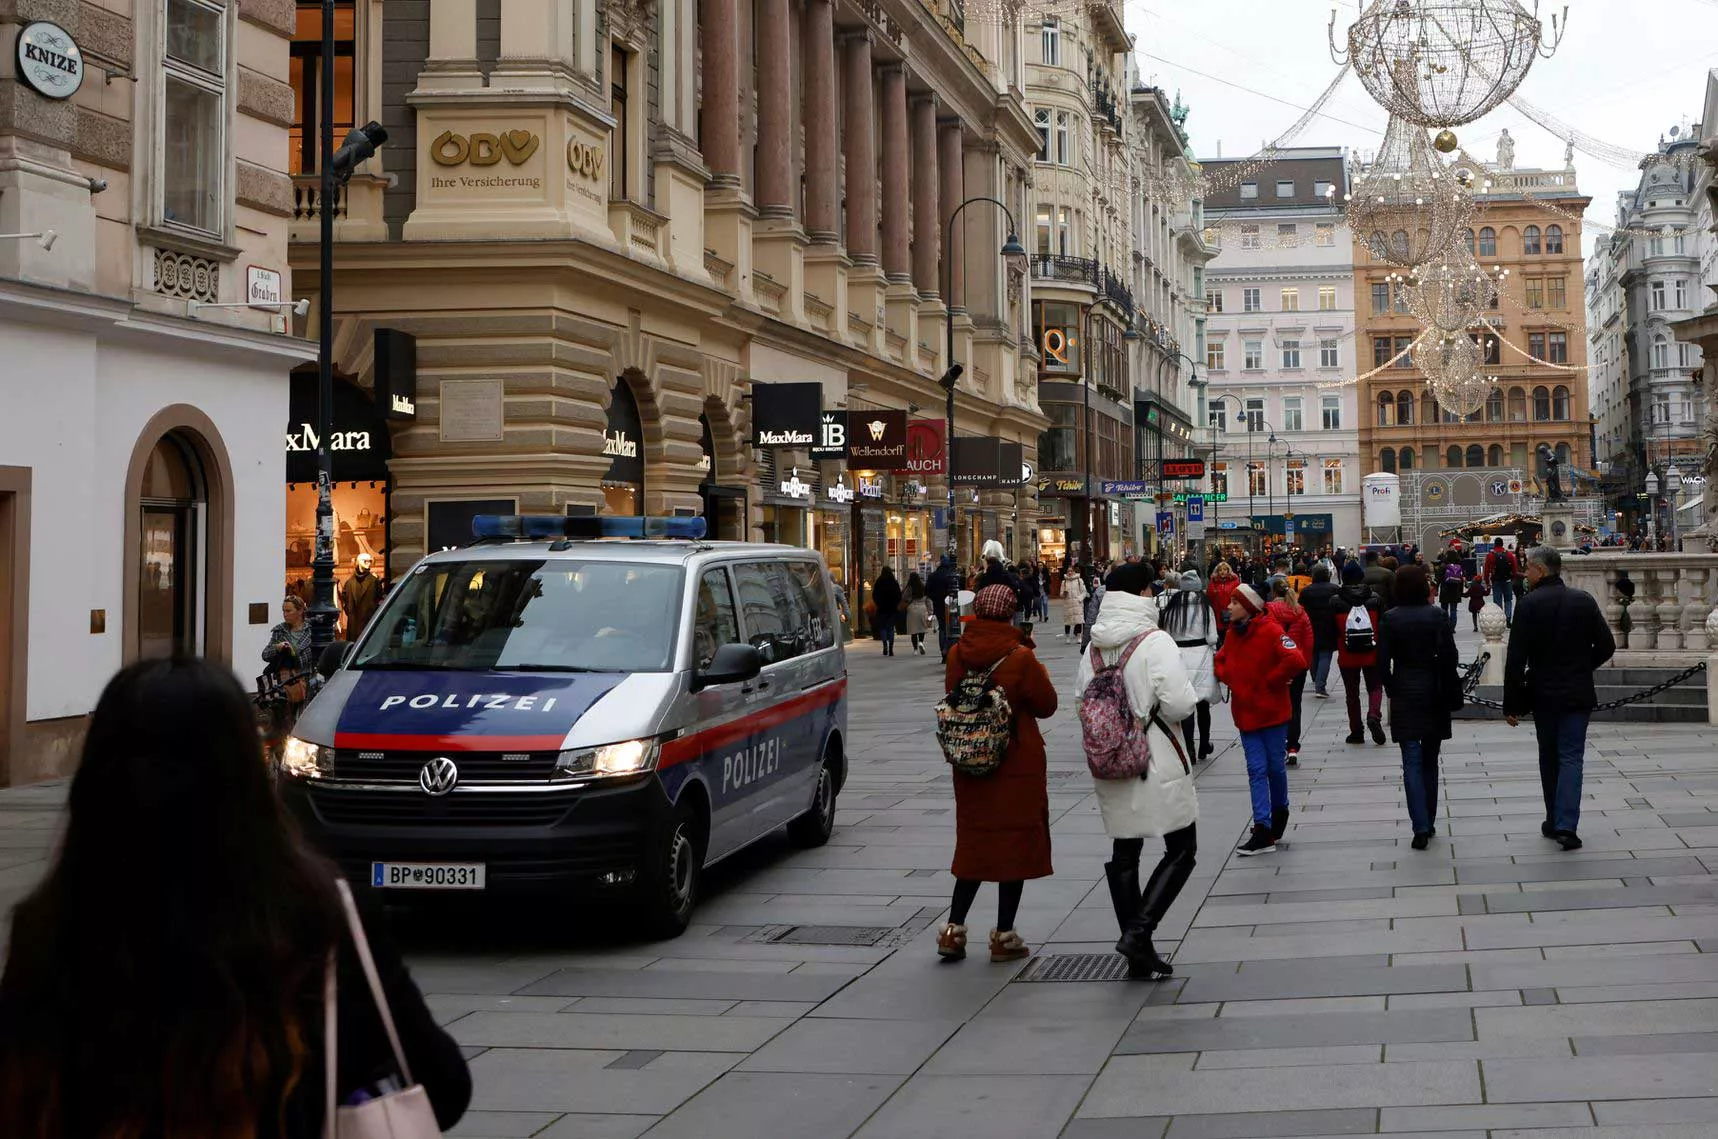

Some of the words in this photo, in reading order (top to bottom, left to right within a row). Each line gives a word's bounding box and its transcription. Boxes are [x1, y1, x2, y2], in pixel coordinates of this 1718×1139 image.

[25, 43, 77, 75] KNIZE
[431, 177, 457, 188] Ihre
[460, 176, 540, 189] Versicherung
[759, 429, 813, 445] MaxMara
[850, 444, 905, 457] Wellendorff
[1056, 479, 1085, 491] Tchibo
[1115, 483, 1143, 493] Tchibo
[1372, 487, 1391, 495] Profi
[379, 694, 557, 712] POLIZEI
[722, 737, 780, 795] POLIZEI
[390, 867, 412, 884] BP
[424, 867, 476, 885] 90331
